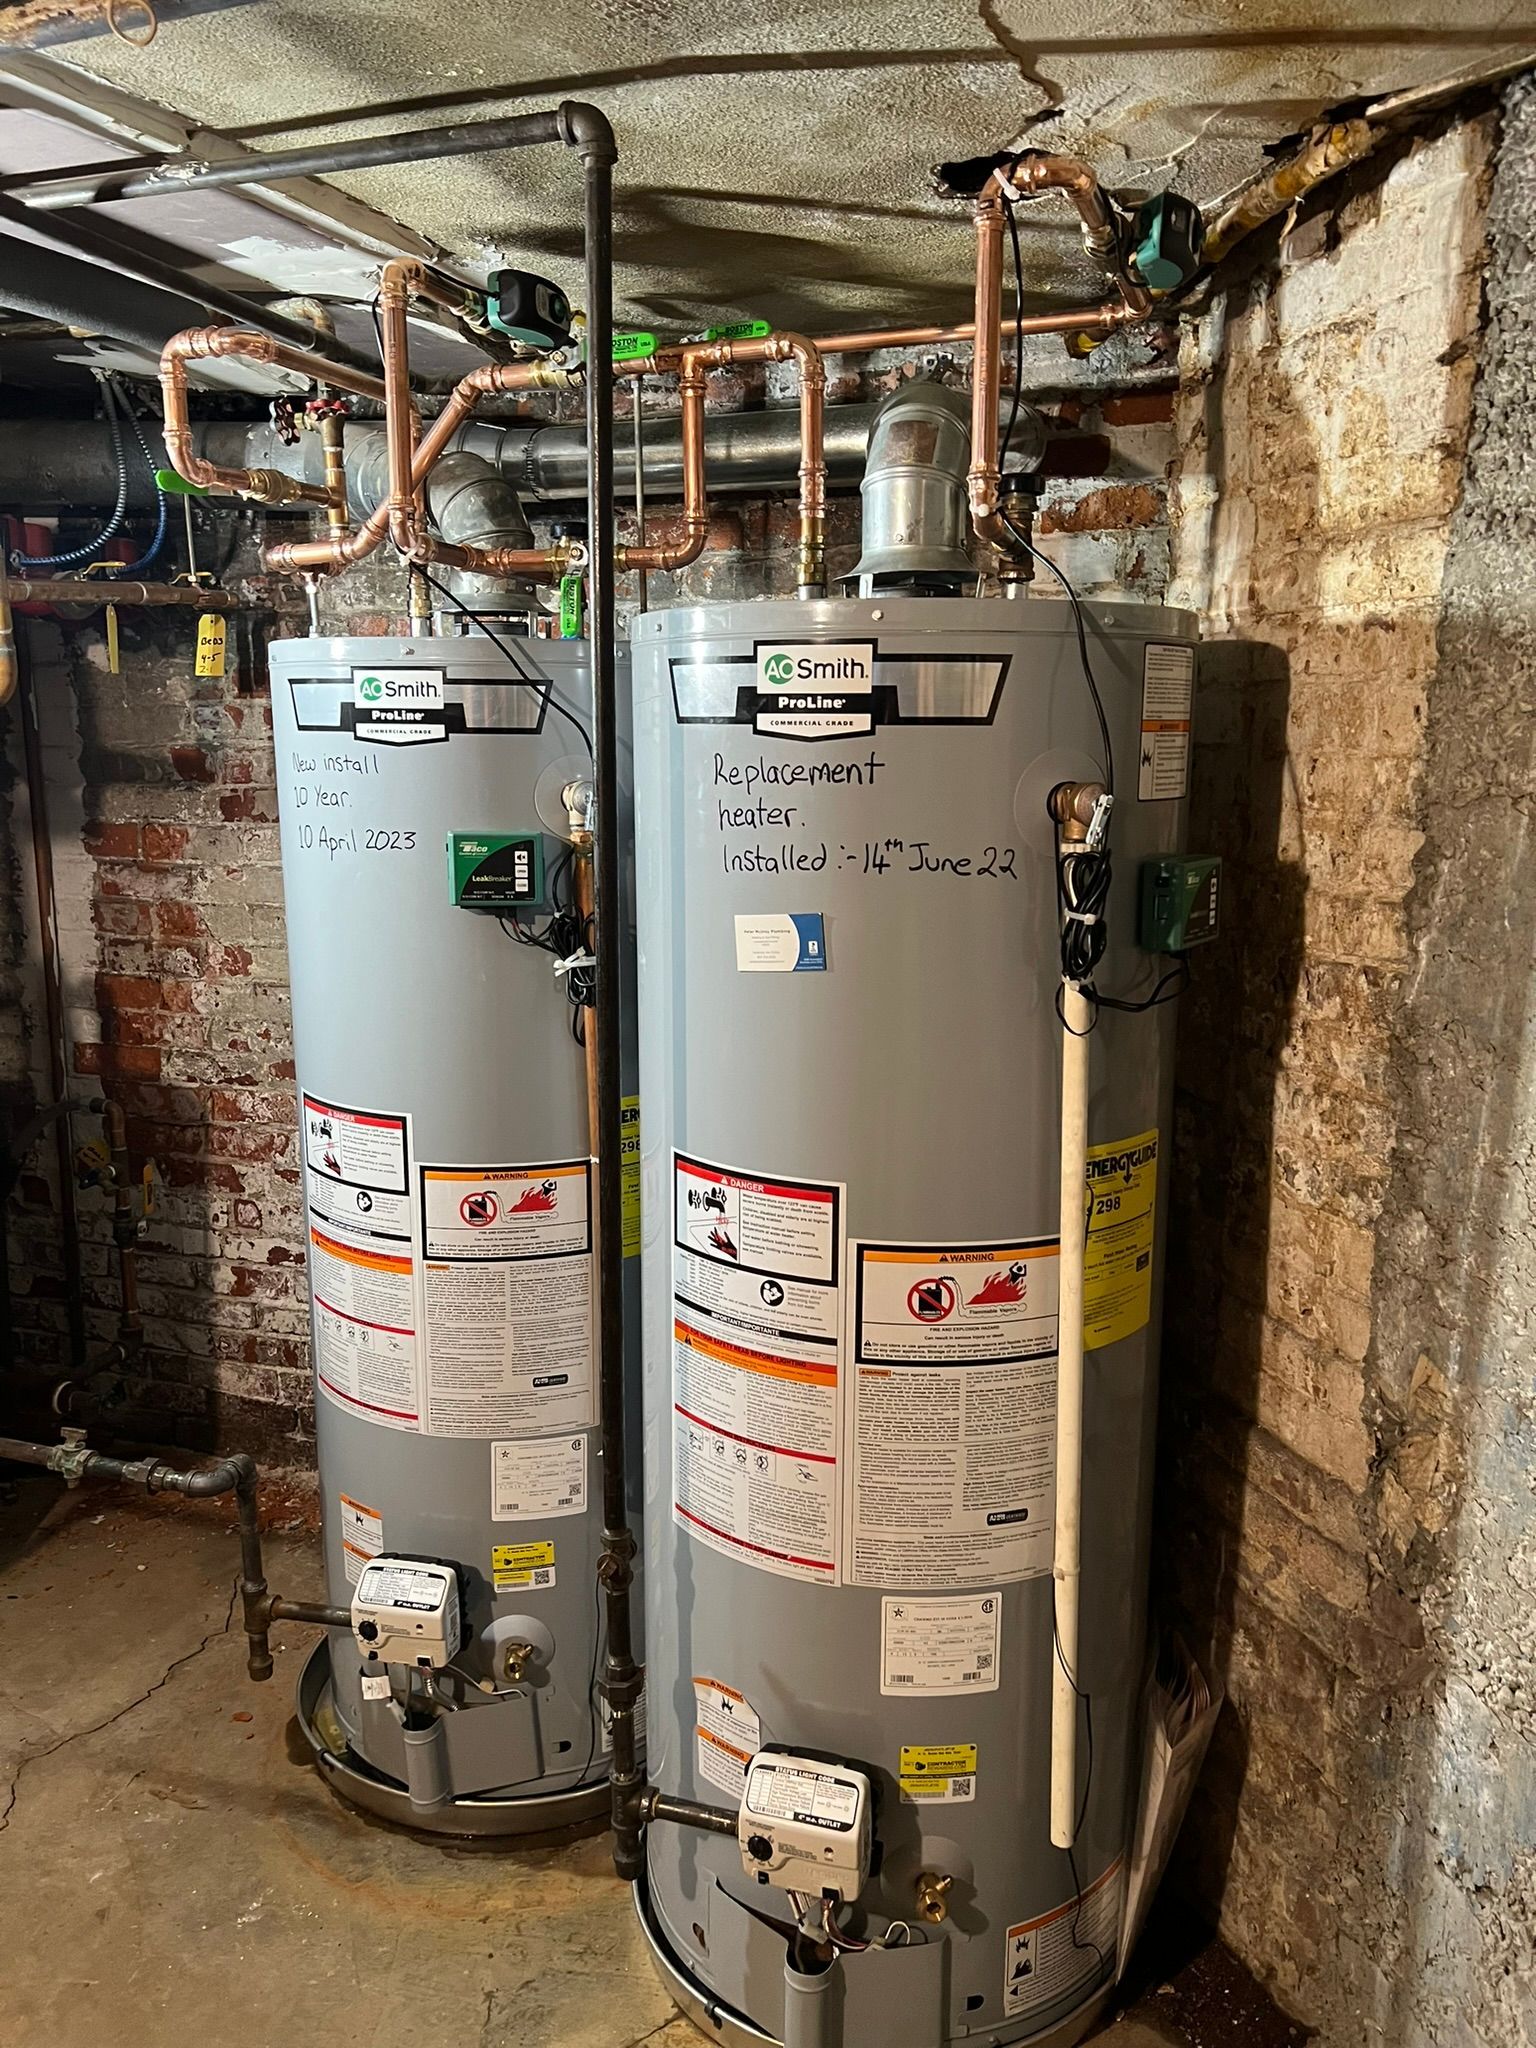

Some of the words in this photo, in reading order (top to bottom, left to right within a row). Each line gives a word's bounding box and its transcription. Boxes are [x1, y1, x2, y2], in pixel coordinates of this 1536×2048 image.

[612, 337, 638, 346] OSTON
[292, 752, 316, 773] New
[324, 753, 379, 774] install
[714, 751, 886, 795] Replacement
[294, 786, 308, 808] 10
[718, 797, 805, 831] heater.
[299, 824, 313, 849] 10
[319, 826, 357, 861] April
[366, 829, 417, 850] 2023
[724, 842, 827, 874] Installed
[909, 843, 972, 876] June
[977, 847, 1017, 880] 22
[334, 1112, 355, 1122] DANGER
[1086, 1141, 1157, 1181] ENERGYGUIDE
[731, 1178, 765, 1192] DANGER
[1095, 1196, 1120, 1215] 298
[950, 1253, 994, 1262] WARNING
[751, 1350, 773, 1361] BEFORE
[774, 1356, 806, 1367] LIGHTING
[716, 1682, 744, 1702] WARNING
[716, 1740, 745, 1759] WARNING
[775, 1766, 798, 1776] STATUS
[799, 1771, 817, 1780] LIGHT
[818, 1775, 835, 1784] CODE
[818, 1819, 841, 1829] OUTLET
